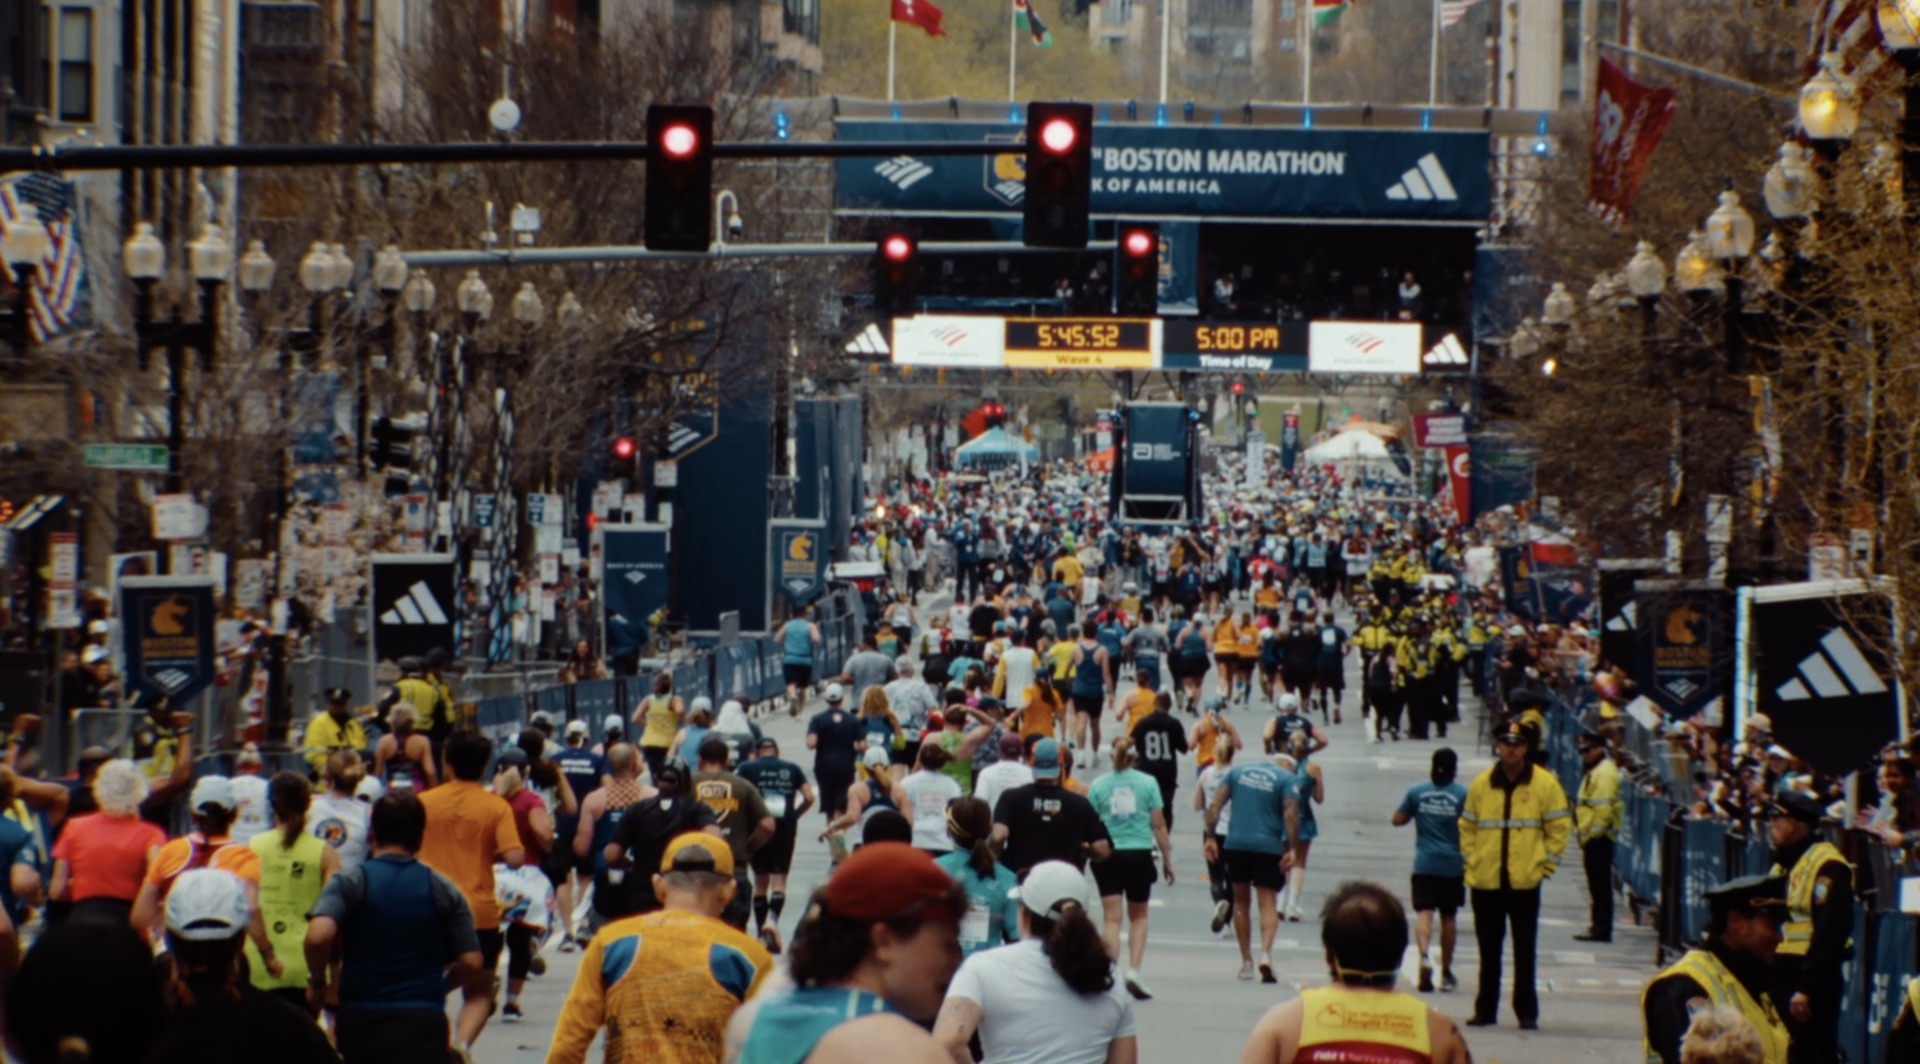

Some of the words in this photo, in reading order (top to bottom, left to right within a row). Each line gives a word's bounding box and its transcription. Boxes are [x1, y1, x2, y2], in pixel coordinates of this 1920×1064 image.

[1104, 148, 1201, 172] BOSTON
[1207, 150, 1345, 175] MARATHON
[1107, 178, 1132, 193] OF
[1135, 178, 1221, 194] AMERICA
[1037, 325, 1120, 347] 5:45:52
[1197, 327, 1245, 350] 5:00
[1250, 328, 1279, 349] PM
[1056, 354, 1090, 364] Wave
[1199, 355, 1231, 368] Time
[1232, 355, 1247, 368] of
[1247, 356, 1273, 370] Day
[1144, 730, 1173, 761] 81
